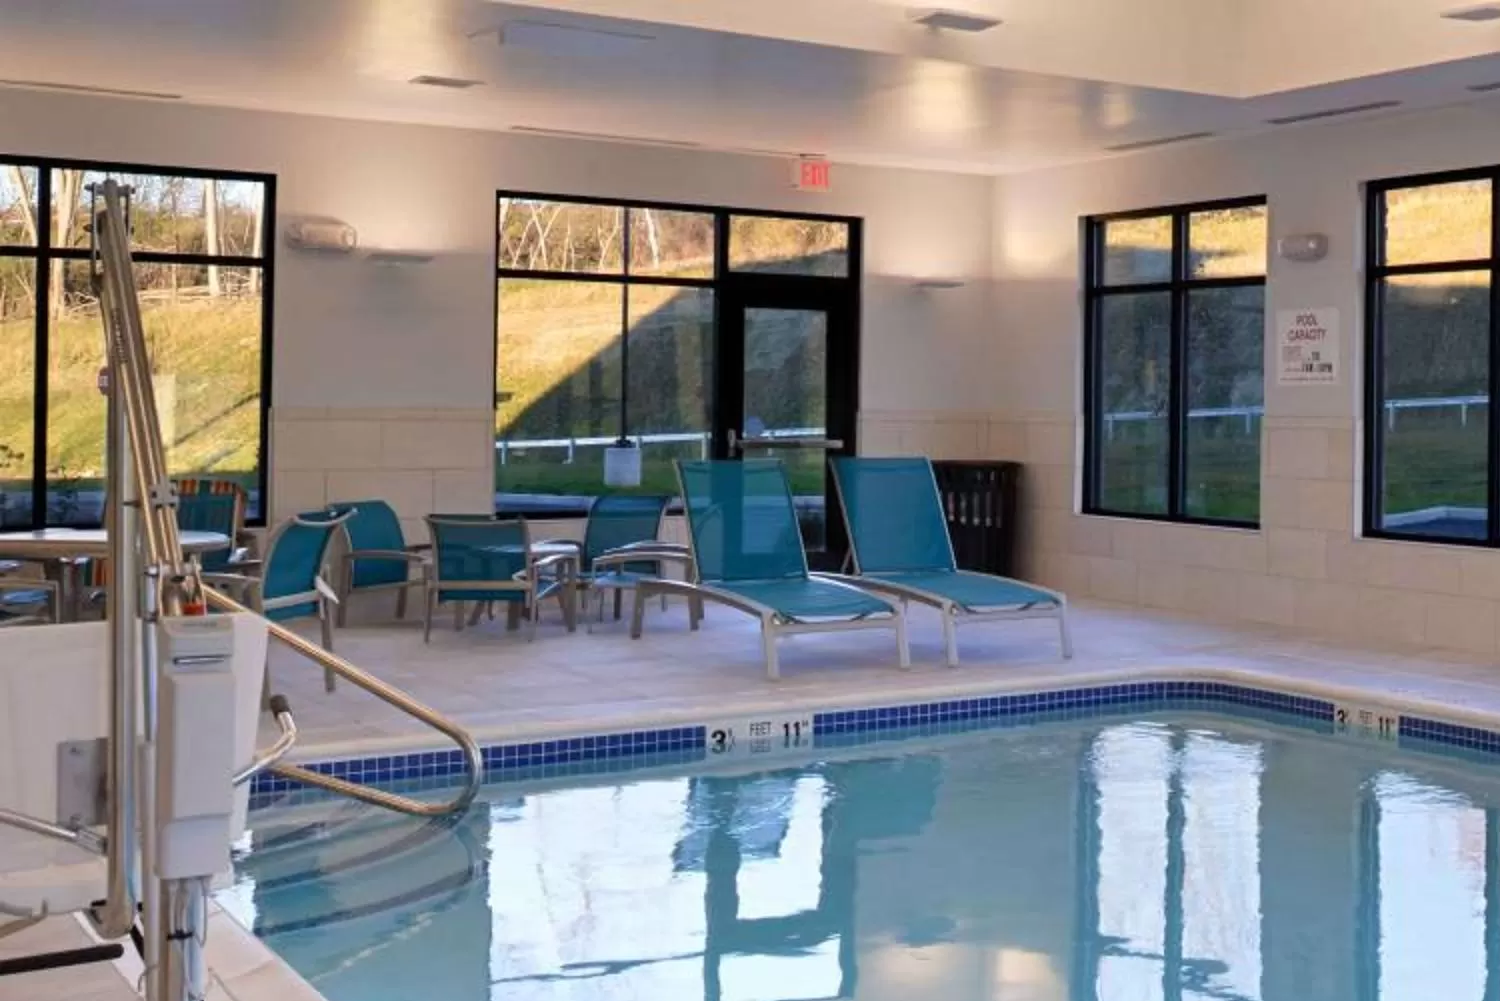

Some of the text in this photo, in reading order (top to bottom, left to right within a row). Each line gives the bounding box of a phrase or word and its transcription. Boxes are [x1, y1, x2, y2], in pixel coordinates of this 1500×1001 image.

[1296, 314, 1318, 327] POOL
[1287, 328, 1327, 341] CAPACITY
[749, 721, 772, 737] FEET
